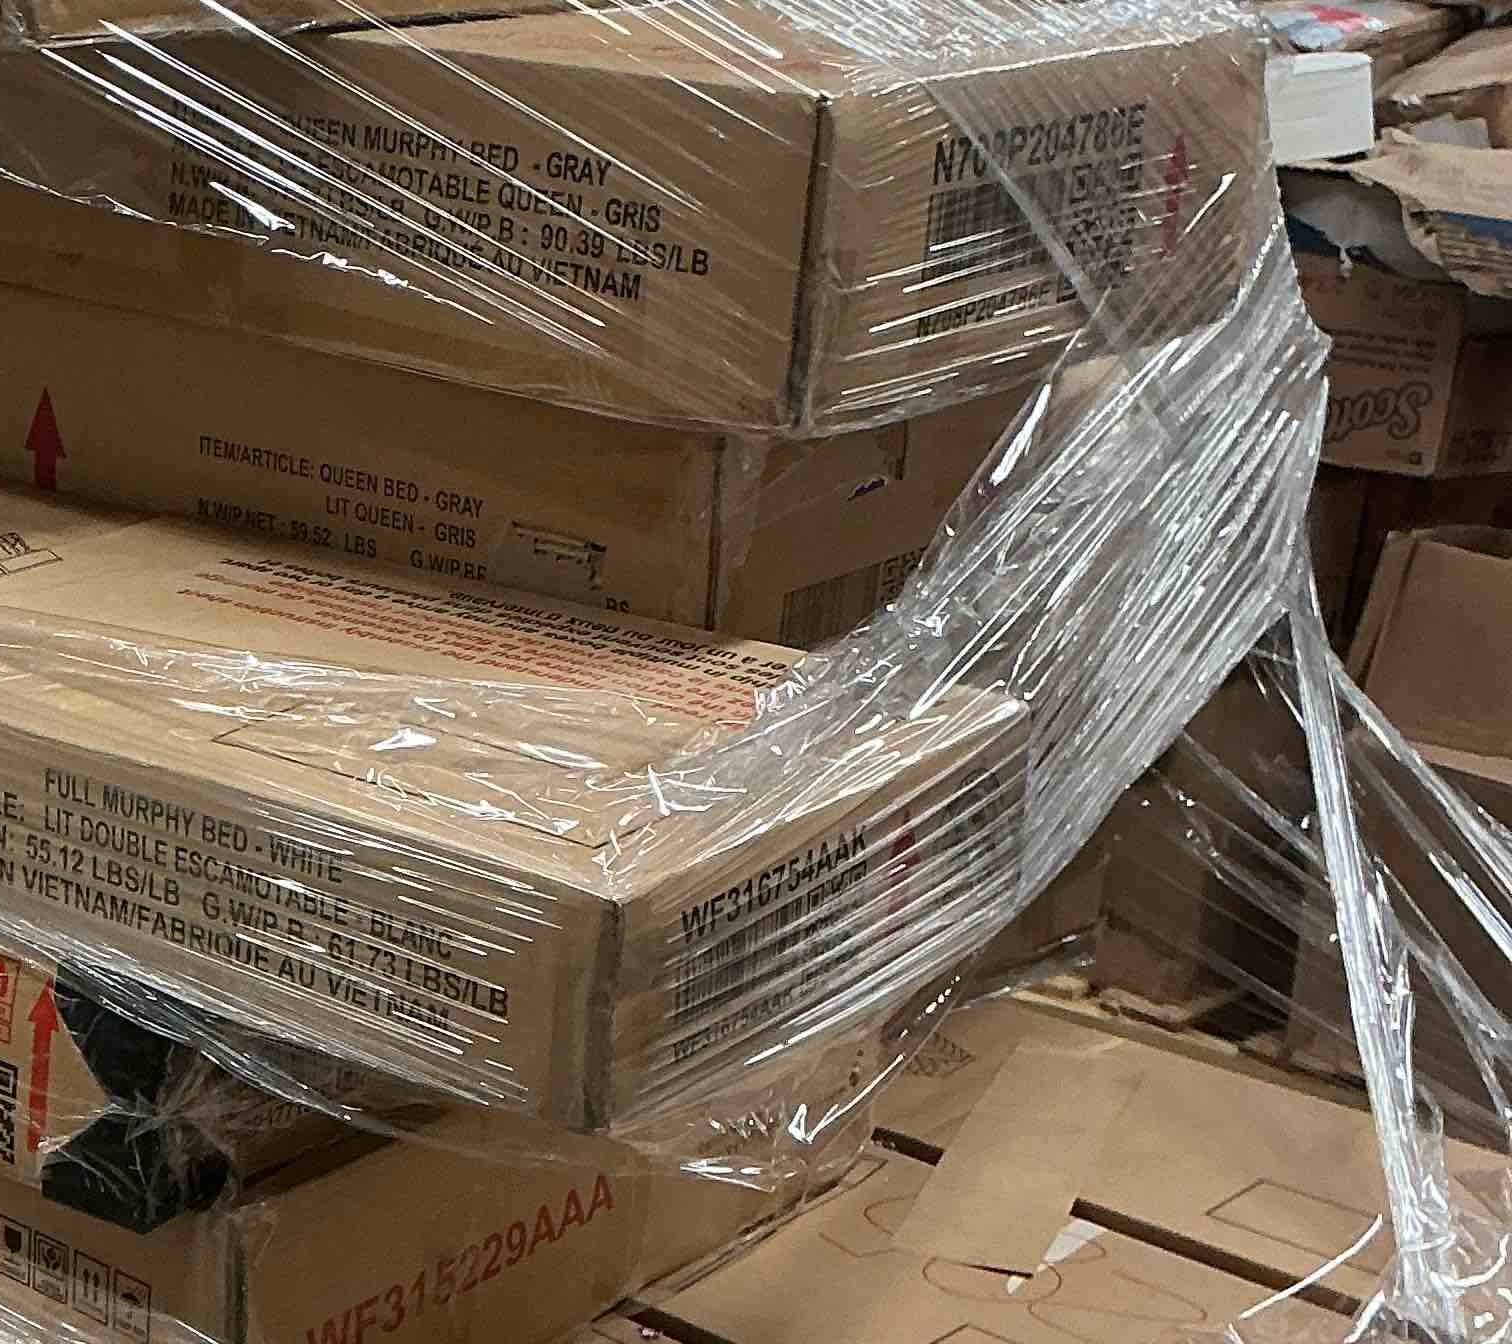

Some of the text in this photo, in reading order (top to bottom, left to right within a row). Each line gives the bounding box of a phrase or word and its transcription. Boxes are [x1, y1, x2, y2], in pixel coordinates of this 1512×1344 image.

[469, 141, 521, 172] BED
[545, 151, 612, 186] GRAY
[497, 182, 664, 233] QUEEN GRIS
[319, 463, 378, 496] QUEEN
[383, 477, 419, 504] BED
[435, 489, 484, 520] GRAY
[289, 519, 332, 547] 59.52
[343, 531, 378, 557] LBS
[325, 495, 478, 550] LIT QUEEN GRIS
[44, 767, 96, 808] FULL
[102, 784, 195, 838] MURPHY
[200, 814, 249, 854] BED
[268, 834, 344, 884] WHITE
[24, 833, 84, 874] 55.12
[90, 856, 181, 907] LBS/LB
[42, 804, 74, 837] LIT
[79, 814, 168, 868] DOUBLE
[174, 844, 349, 927] ESCAMOTABLE
[369, 908, 453, 961] BLANC
[277, 957, 316, 990] AU
